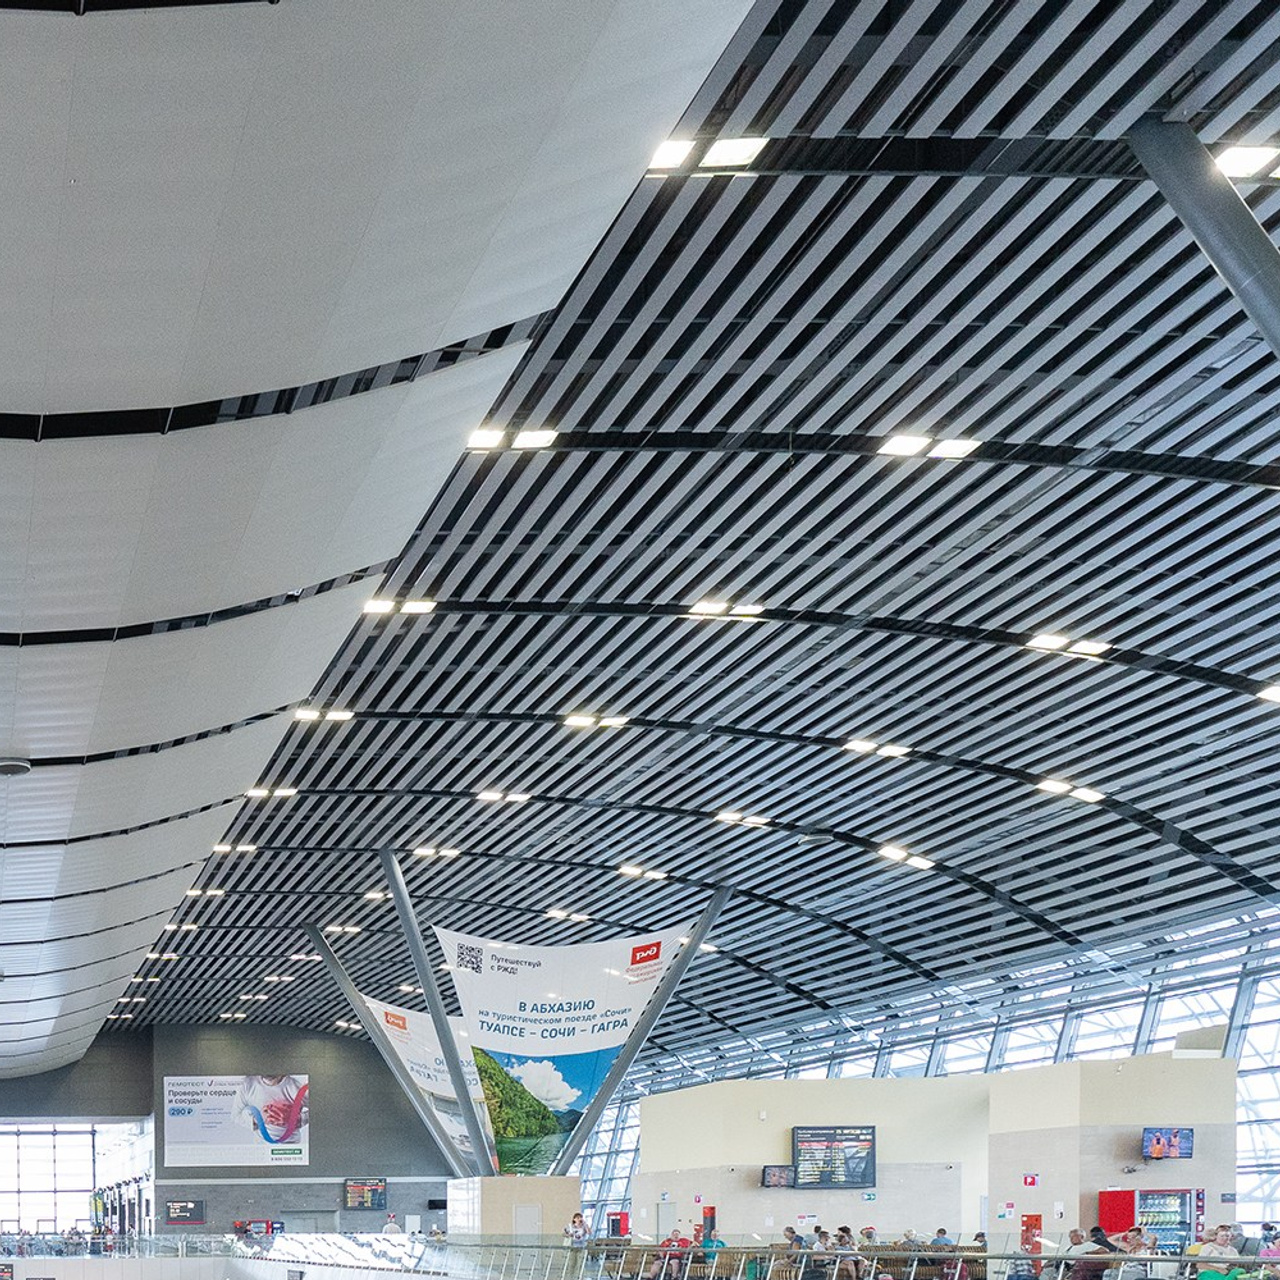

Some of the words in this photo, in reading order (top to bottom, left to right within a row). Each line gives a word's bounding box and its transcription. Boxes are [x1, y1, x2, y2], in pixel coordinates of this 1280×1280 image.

[490, 954, 542, 968] Путешествуй
[518, 1001, 527, 1012] В
[530, 999, 596, 1014] АБХАЗИЮ
[478, 1009, 489, 1017] на
[491, 1011, 562, 1025] туристическом
[565, 1013, 598, 1023] поезде
[599, 1006, 632, 1019] «Сочи»
[478, 1020, 526, 1038] ТУАПСЕ
[540, 1026, 576, 1039] СОЧИ
[590, 1018, 629, 1035] ГАГРА
[167, 1089, 209, 1098] Проверьте
[209, 1090, 237, 1098] сердце
